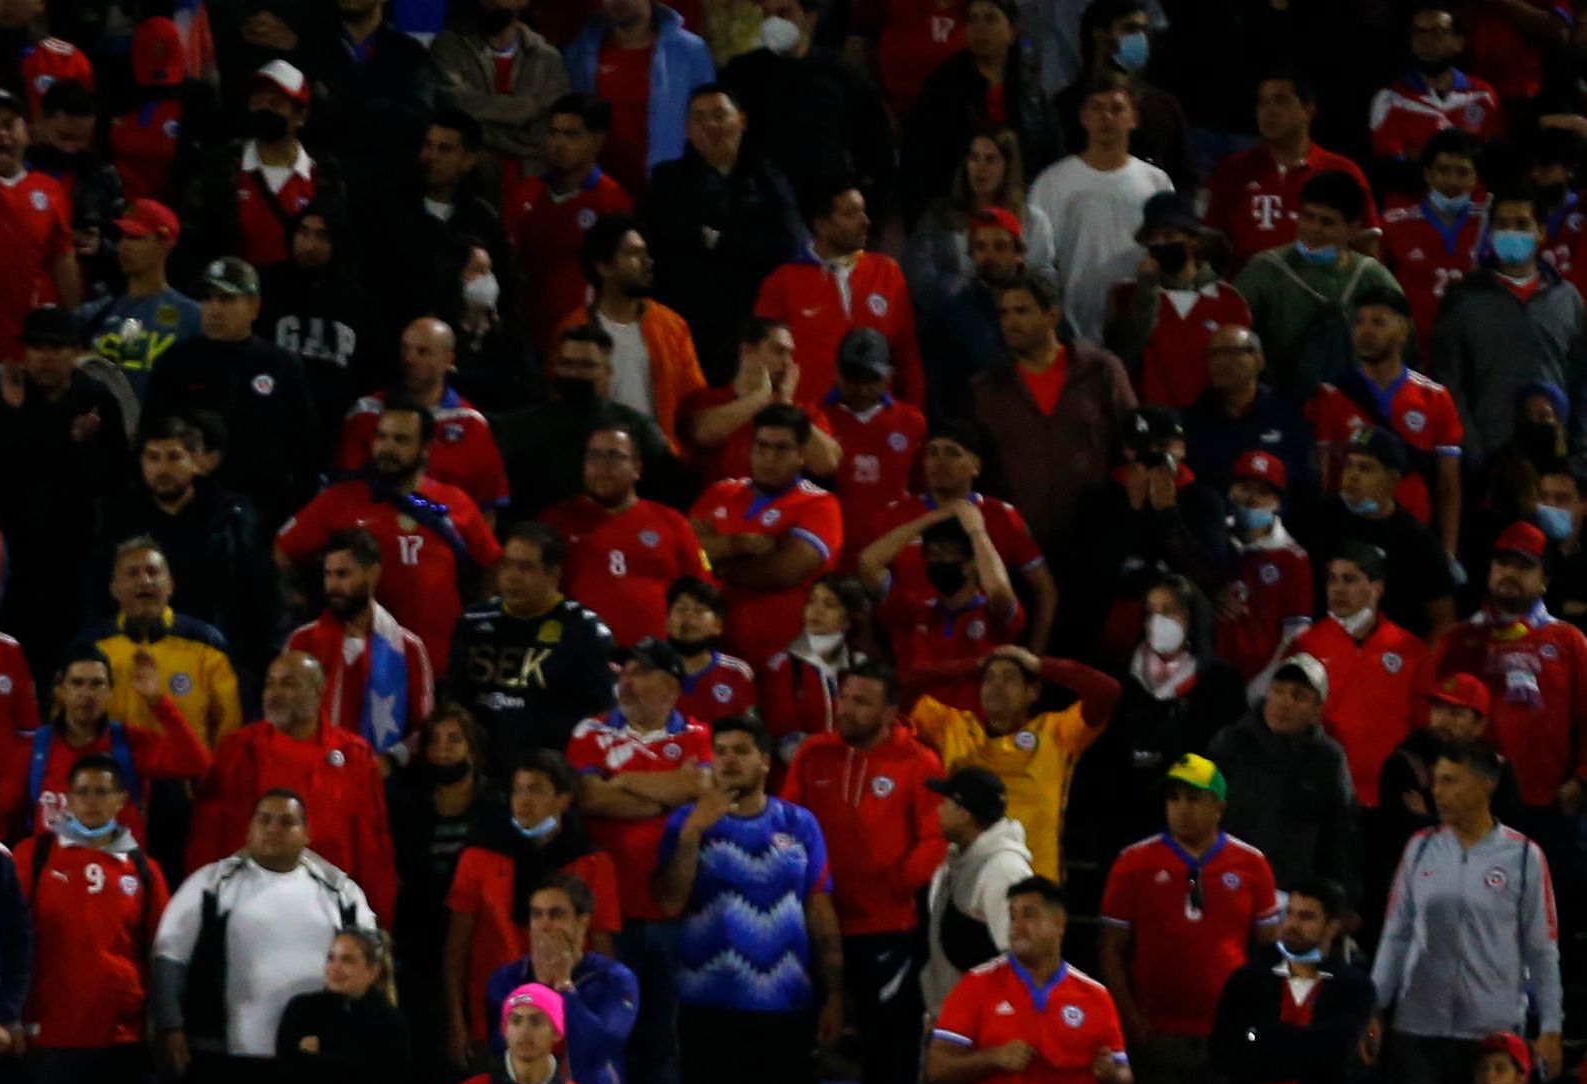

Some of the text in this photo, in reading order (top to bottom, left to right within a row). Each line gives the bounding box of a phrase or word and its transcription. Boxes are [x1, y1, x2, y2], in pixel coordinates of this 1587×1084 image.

[608, 549, 627, 577] 8
[468, 645, 552, 688] SEK
[84, 863, 105, 894] 9
